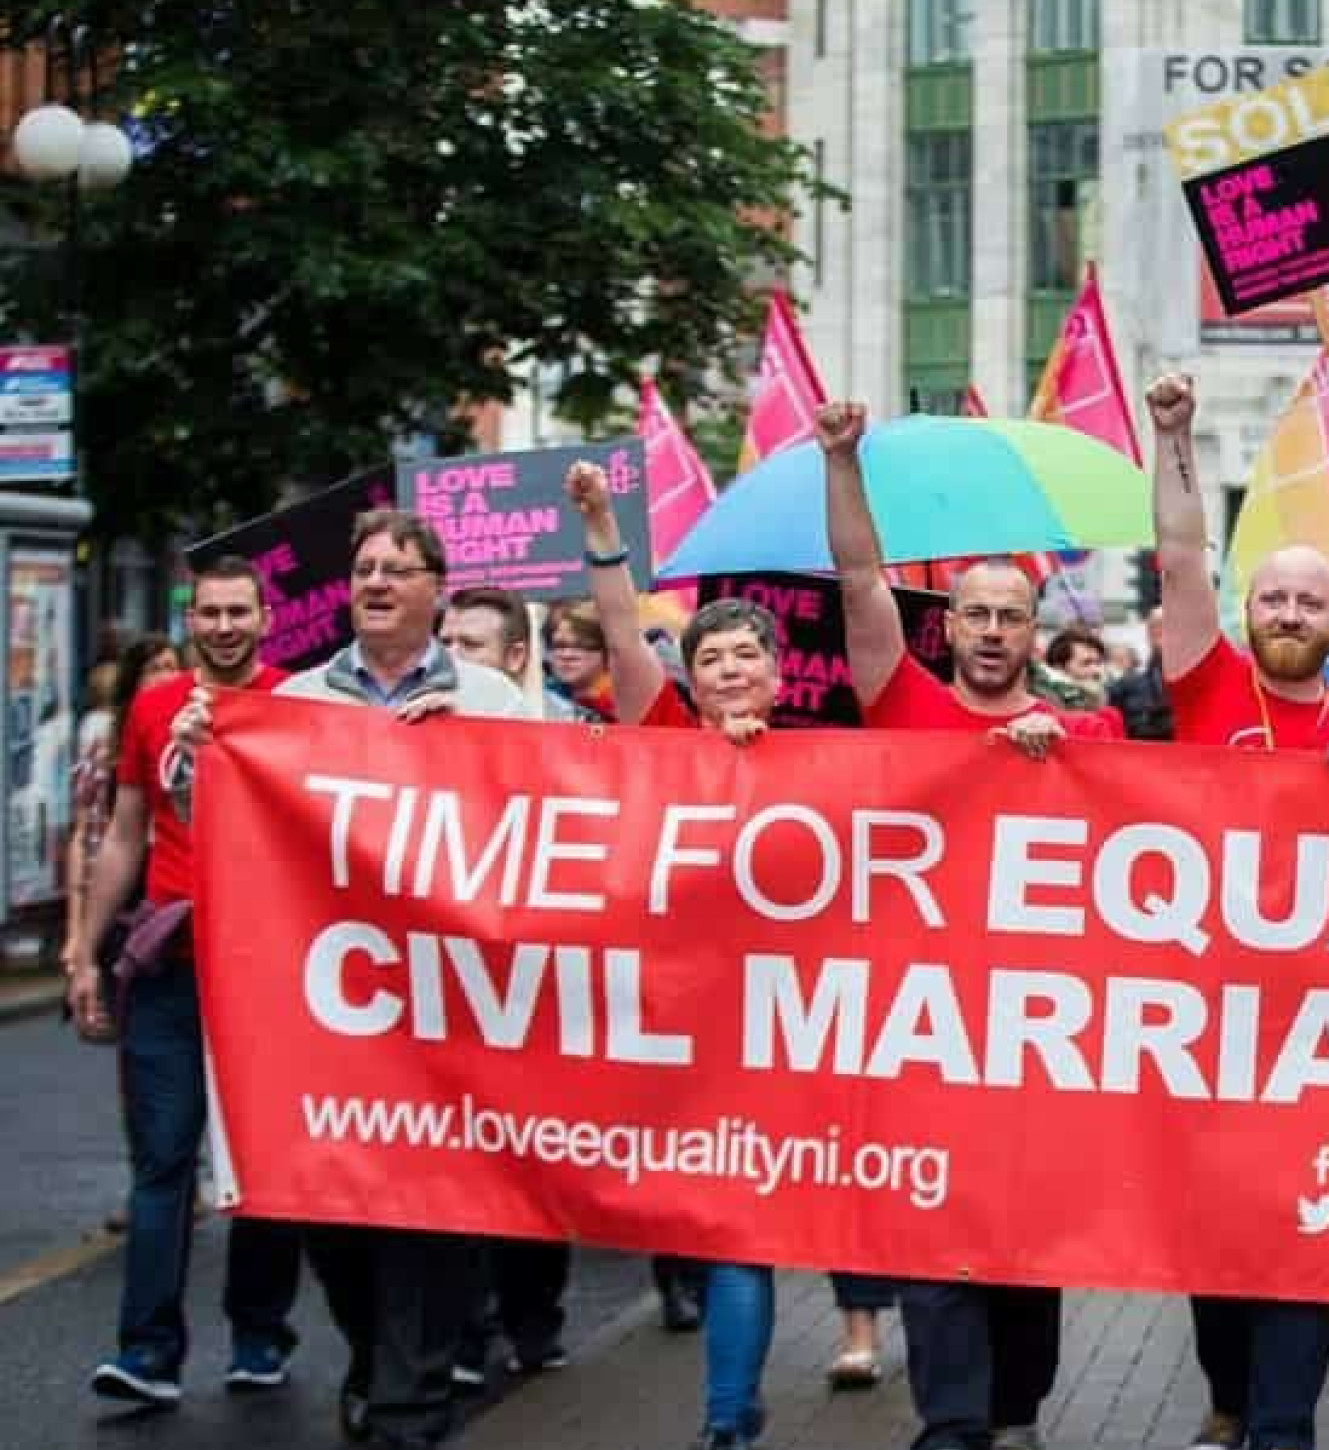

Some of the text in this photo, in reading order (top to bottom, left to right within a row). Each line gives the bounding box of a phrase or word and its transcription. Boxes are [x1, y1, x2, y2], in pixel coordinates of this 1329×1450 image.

[1163, 55, 1265, 94] FOR
[1202, 165, 1273, 202] LOVE
[414, 461, 517, 494] LOVE
[417, 491, 490, 518] IS A
[443, 535, 537, 563] IGHT
[304, 775, 620, 910] TIME
[648, 803, 946, 928] FOR
[302, 921, 694, 1065] CIVIL
[301, 1093, 949, 1209] www.loveequalityni.org
